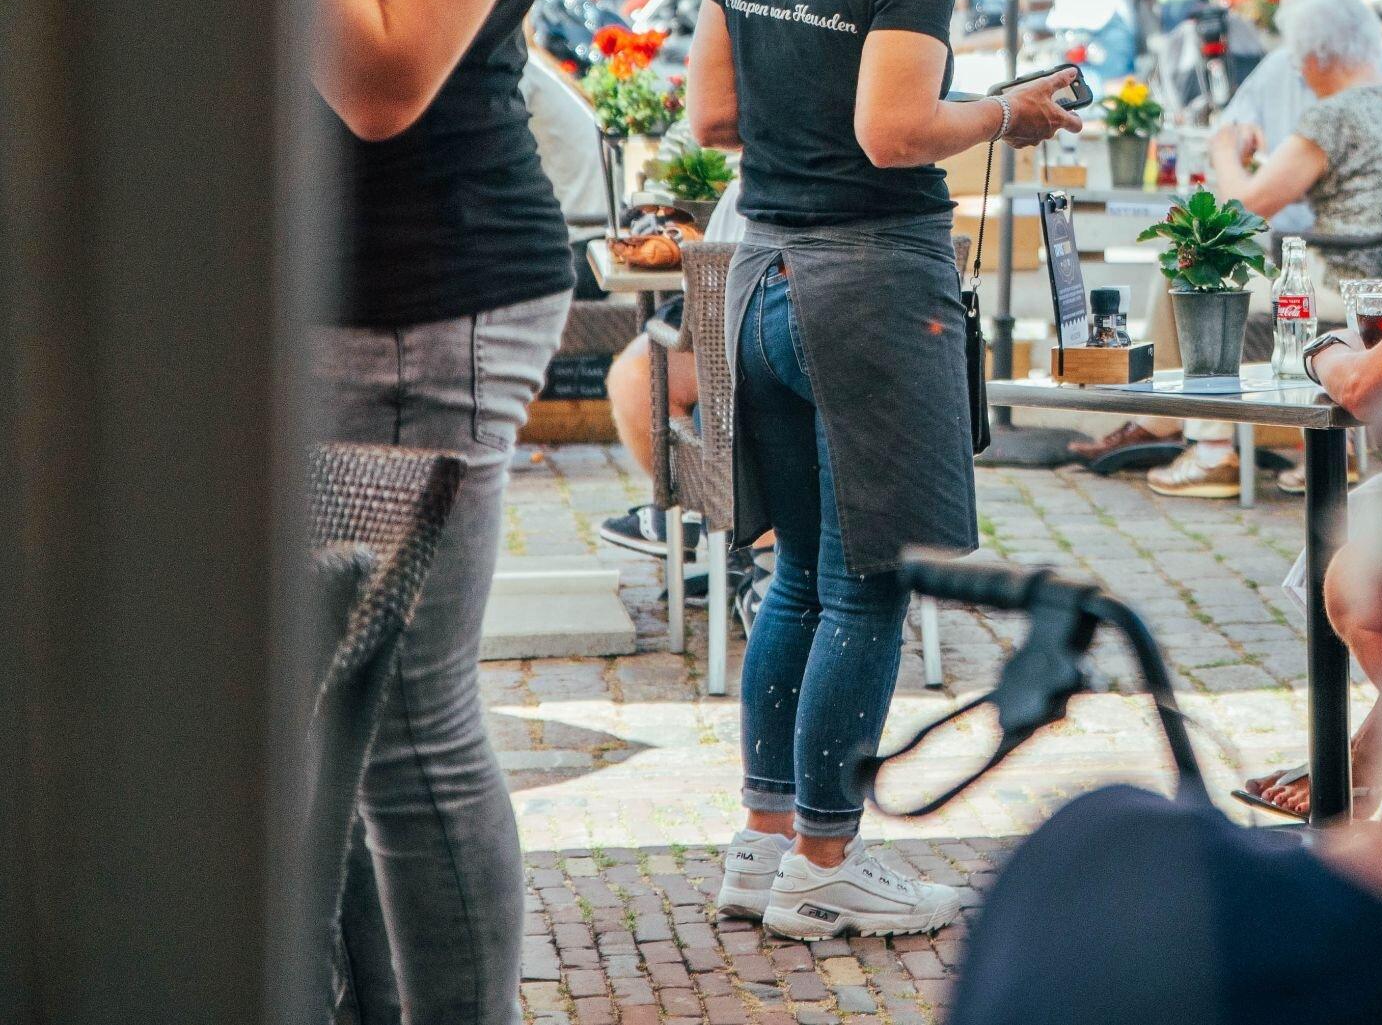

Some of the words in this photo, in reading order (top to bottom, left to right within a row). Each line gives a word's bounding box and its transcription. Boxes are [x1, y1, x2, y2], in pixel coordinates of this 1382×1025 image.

[770, 6, 792, 21] van
[792, 3, 858, 34] Heusden
[736, 852, 754, 861] FILA
